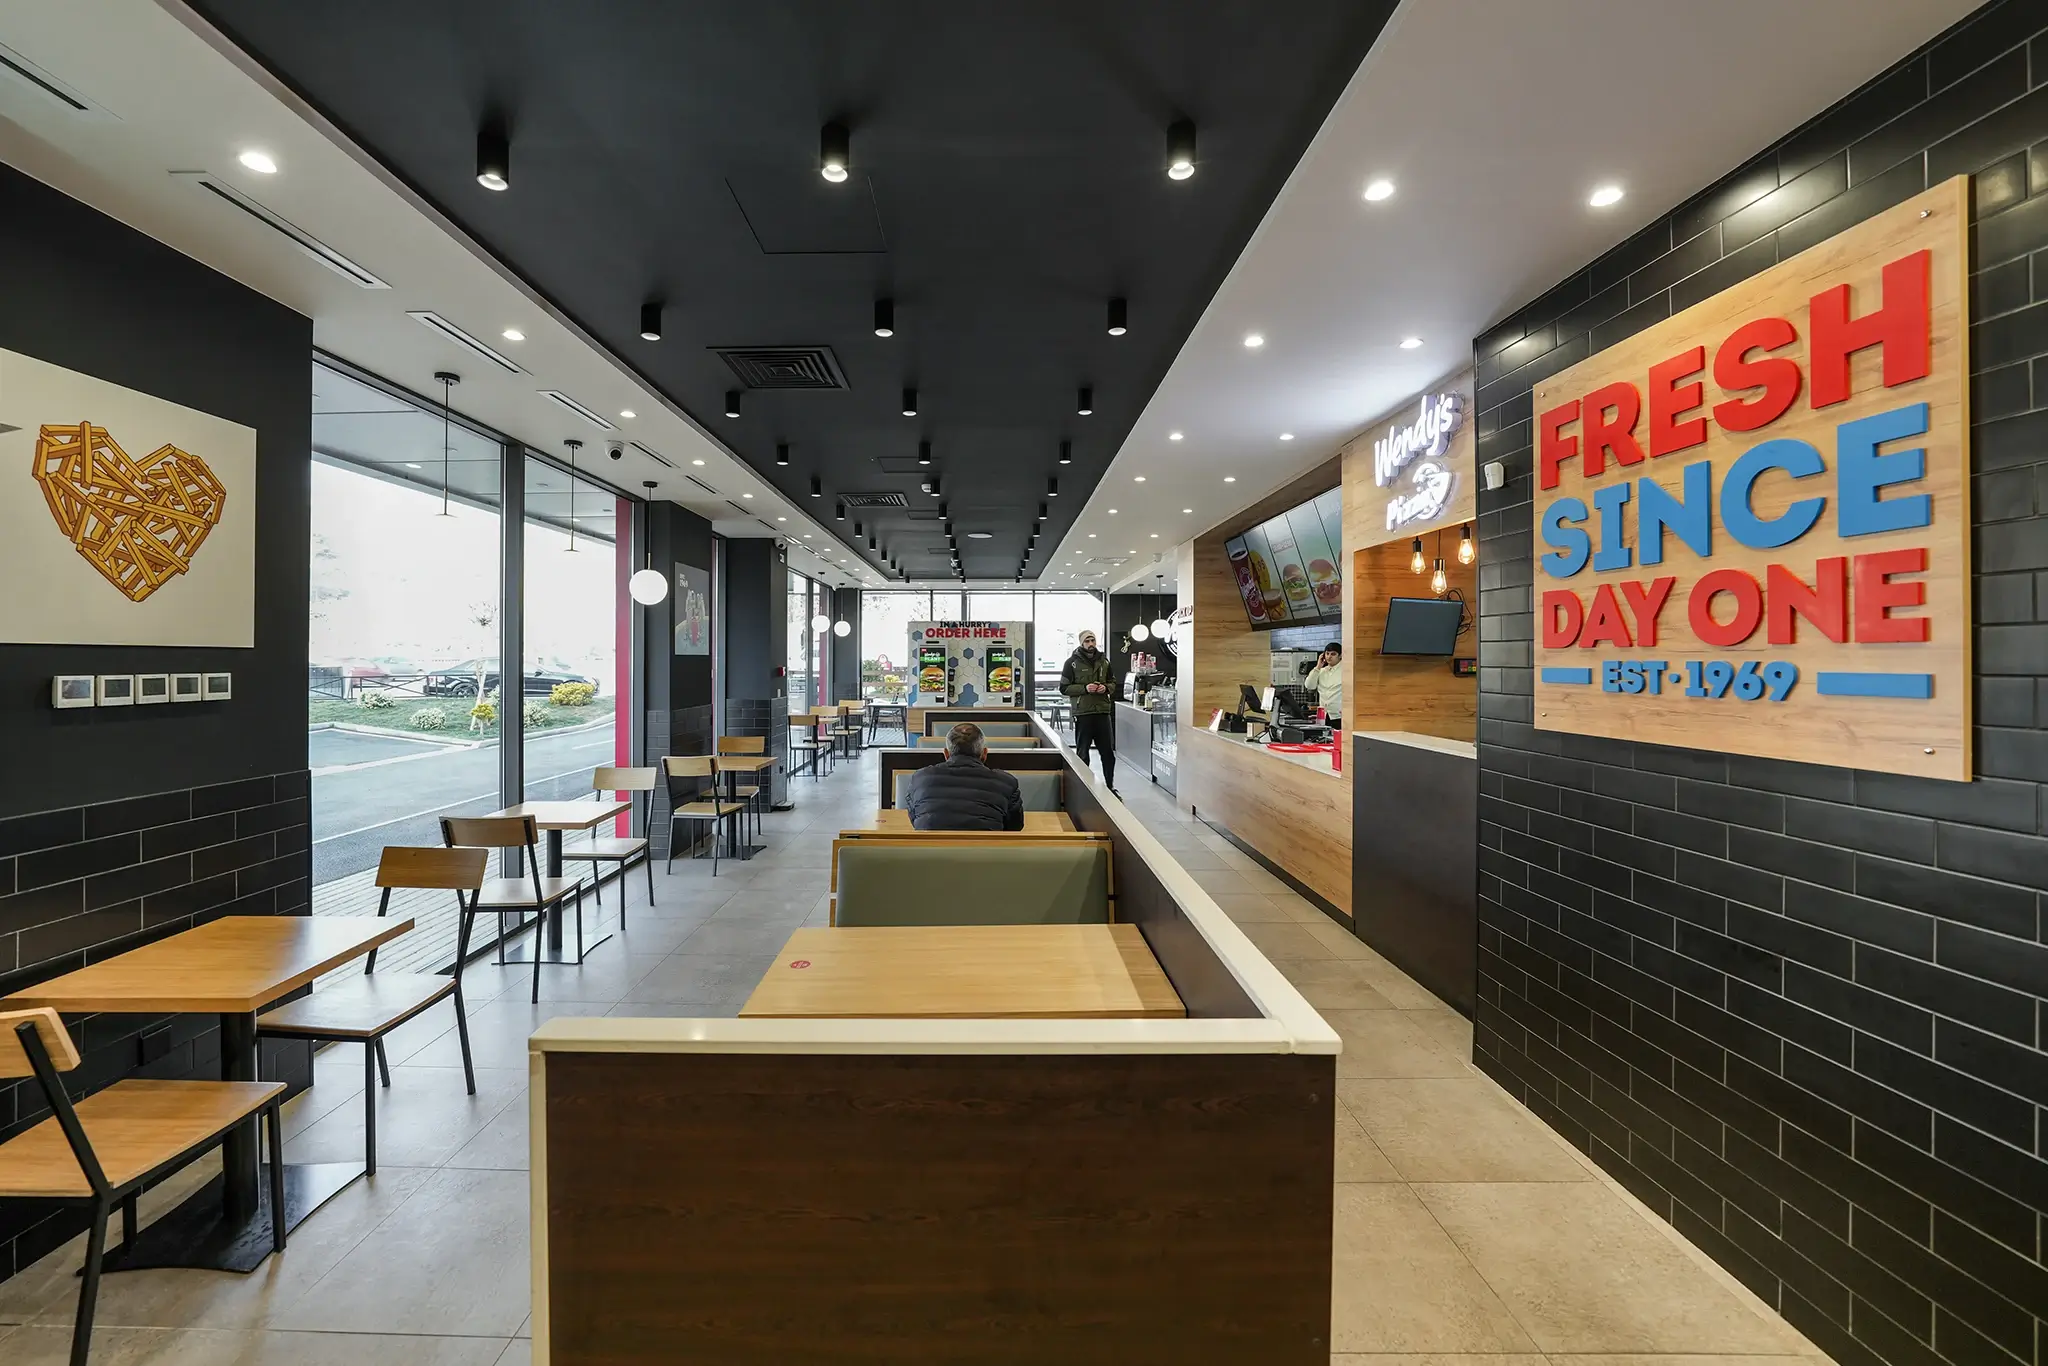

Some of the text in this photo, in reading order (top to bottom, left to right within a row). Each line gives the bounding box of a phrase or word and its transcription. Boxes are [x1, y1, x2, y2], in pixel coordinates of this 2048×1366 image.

[1540, 249, 1930, 491] FRESH
[1374, 392, 1458, 487] Wendy's
[1541, 401, 1931, 578] SINCE
[925, 628, 1007, 638] ORDER HERE
[1542, 548, 1928, 649] DAY ONE
